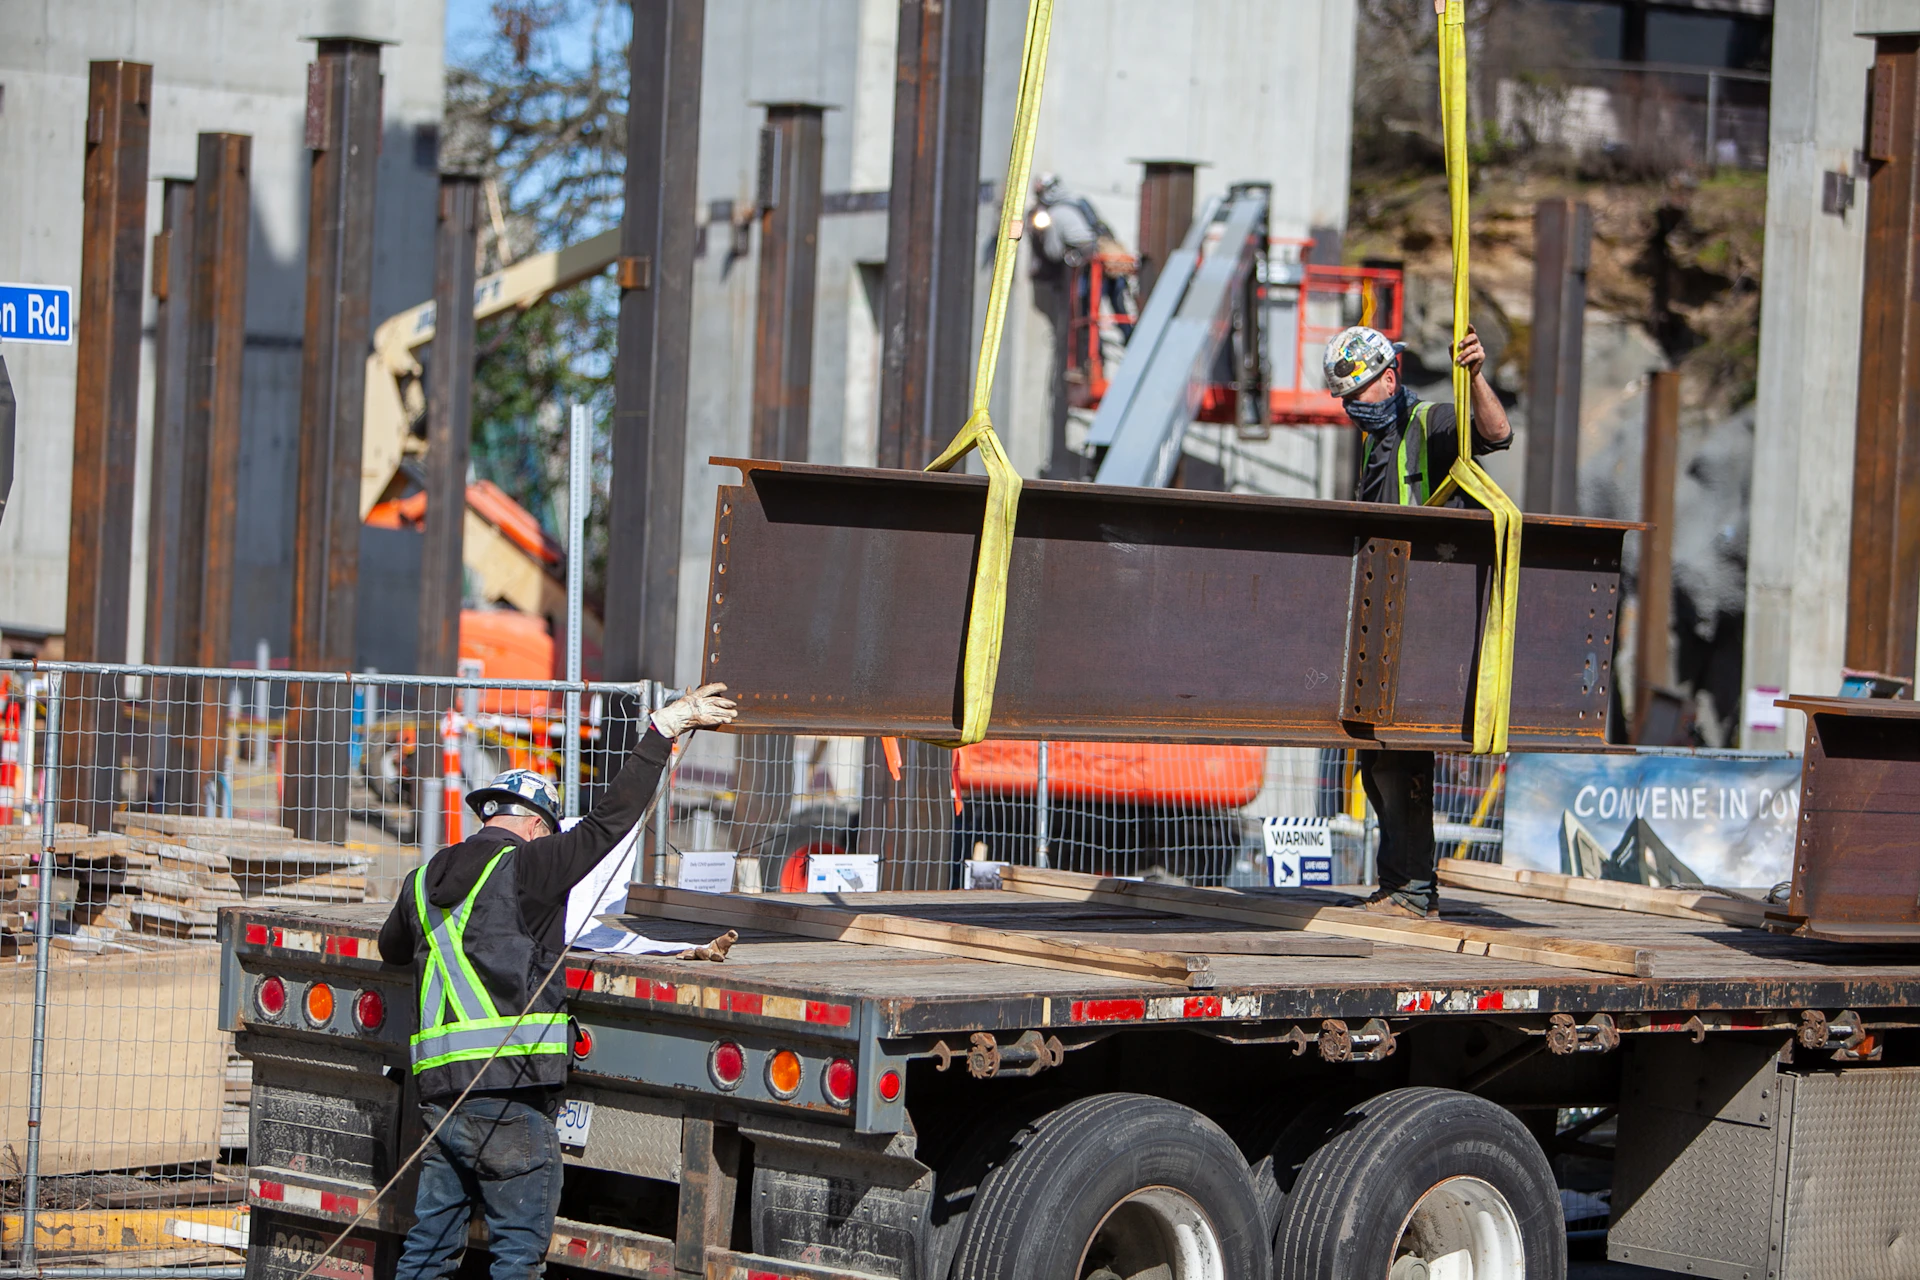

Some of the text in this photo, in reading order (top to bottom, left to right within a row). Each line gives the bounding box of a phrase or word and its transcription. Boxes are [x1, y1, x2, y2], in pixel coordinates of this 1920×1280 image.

[0, 294, 66, 336] n Rd.
[1574, 785, 1707, 819] CONVENE
[1719, 787, 1748, 819] IN
[1271, 831, 1324, 846] WARNING
[566, 1102, 589, 1129] 5U
